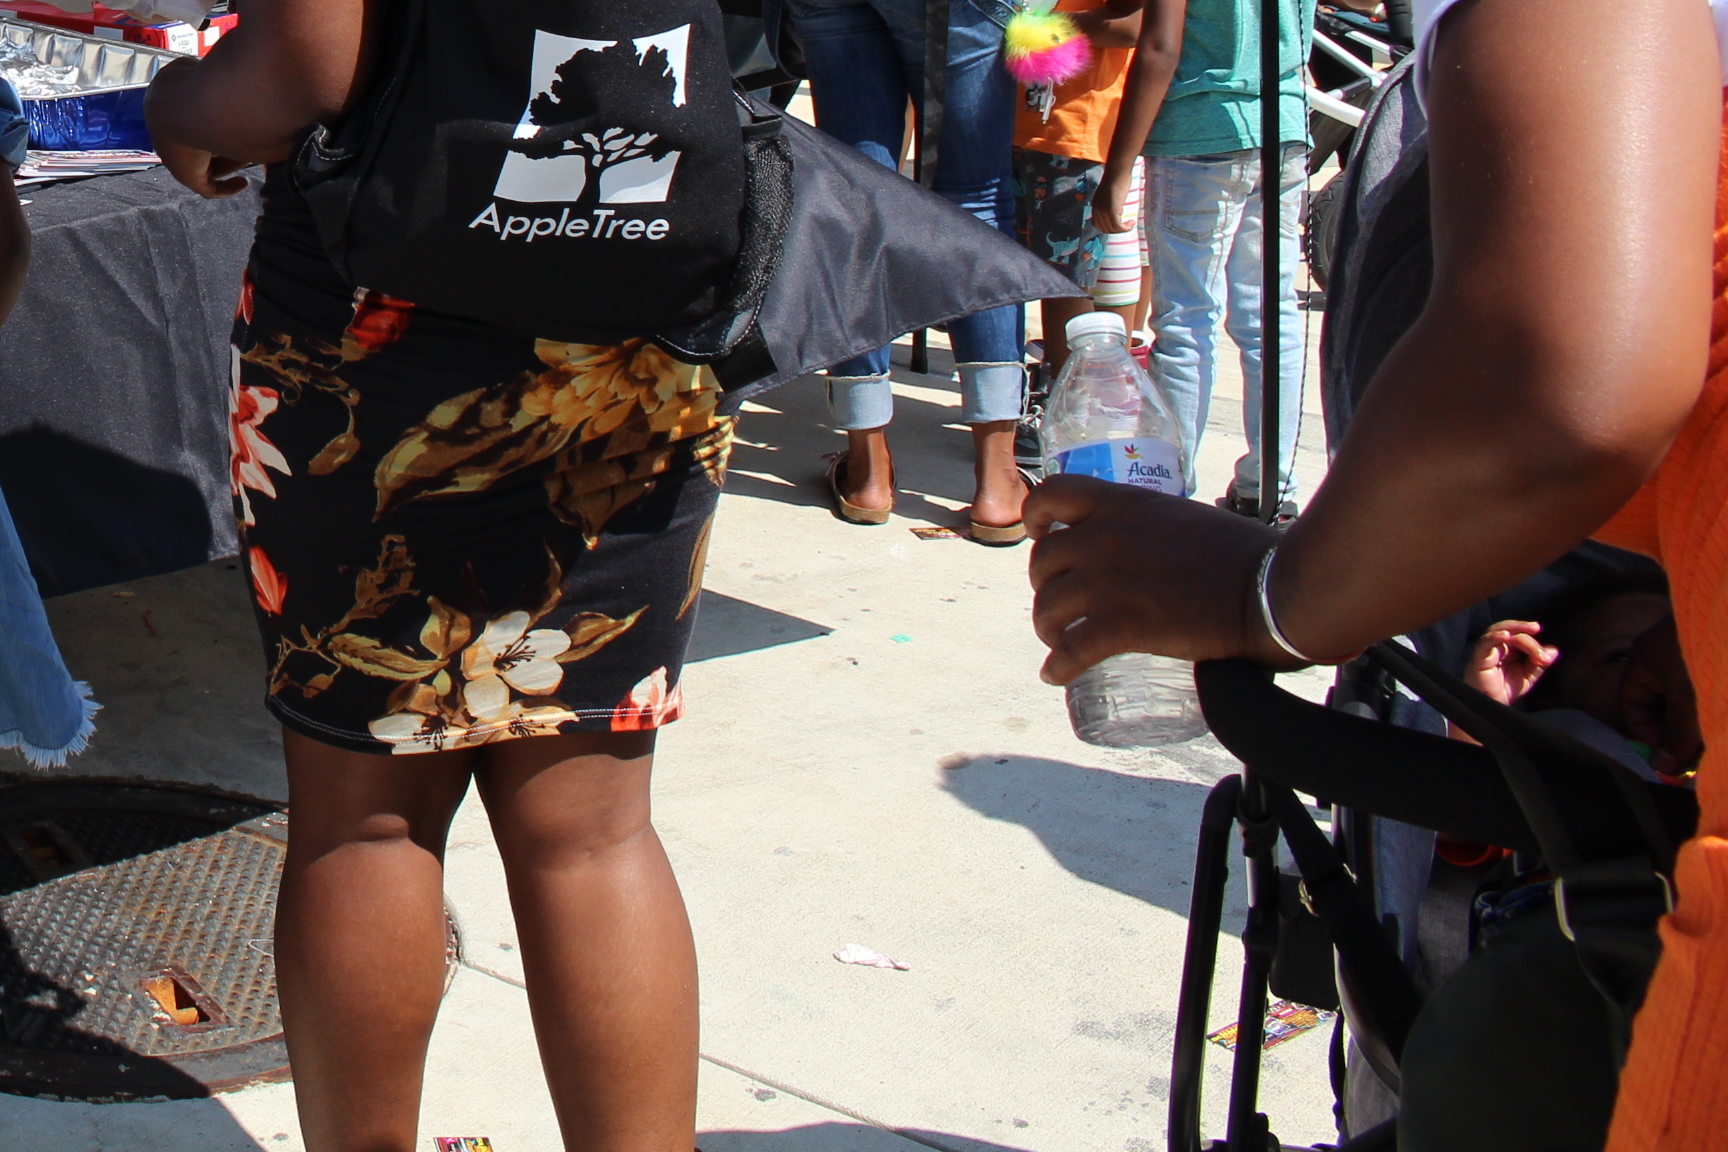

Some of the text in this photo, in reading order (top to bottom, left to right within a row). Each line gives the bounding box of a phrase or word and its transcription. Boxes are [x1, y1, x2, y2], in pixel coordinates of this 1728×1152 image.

[468, 201, 670, 242] AppleTree
[1126, 461, 1173, 479] Acadia
[1128, 477, 1162, 485] NATURAL
